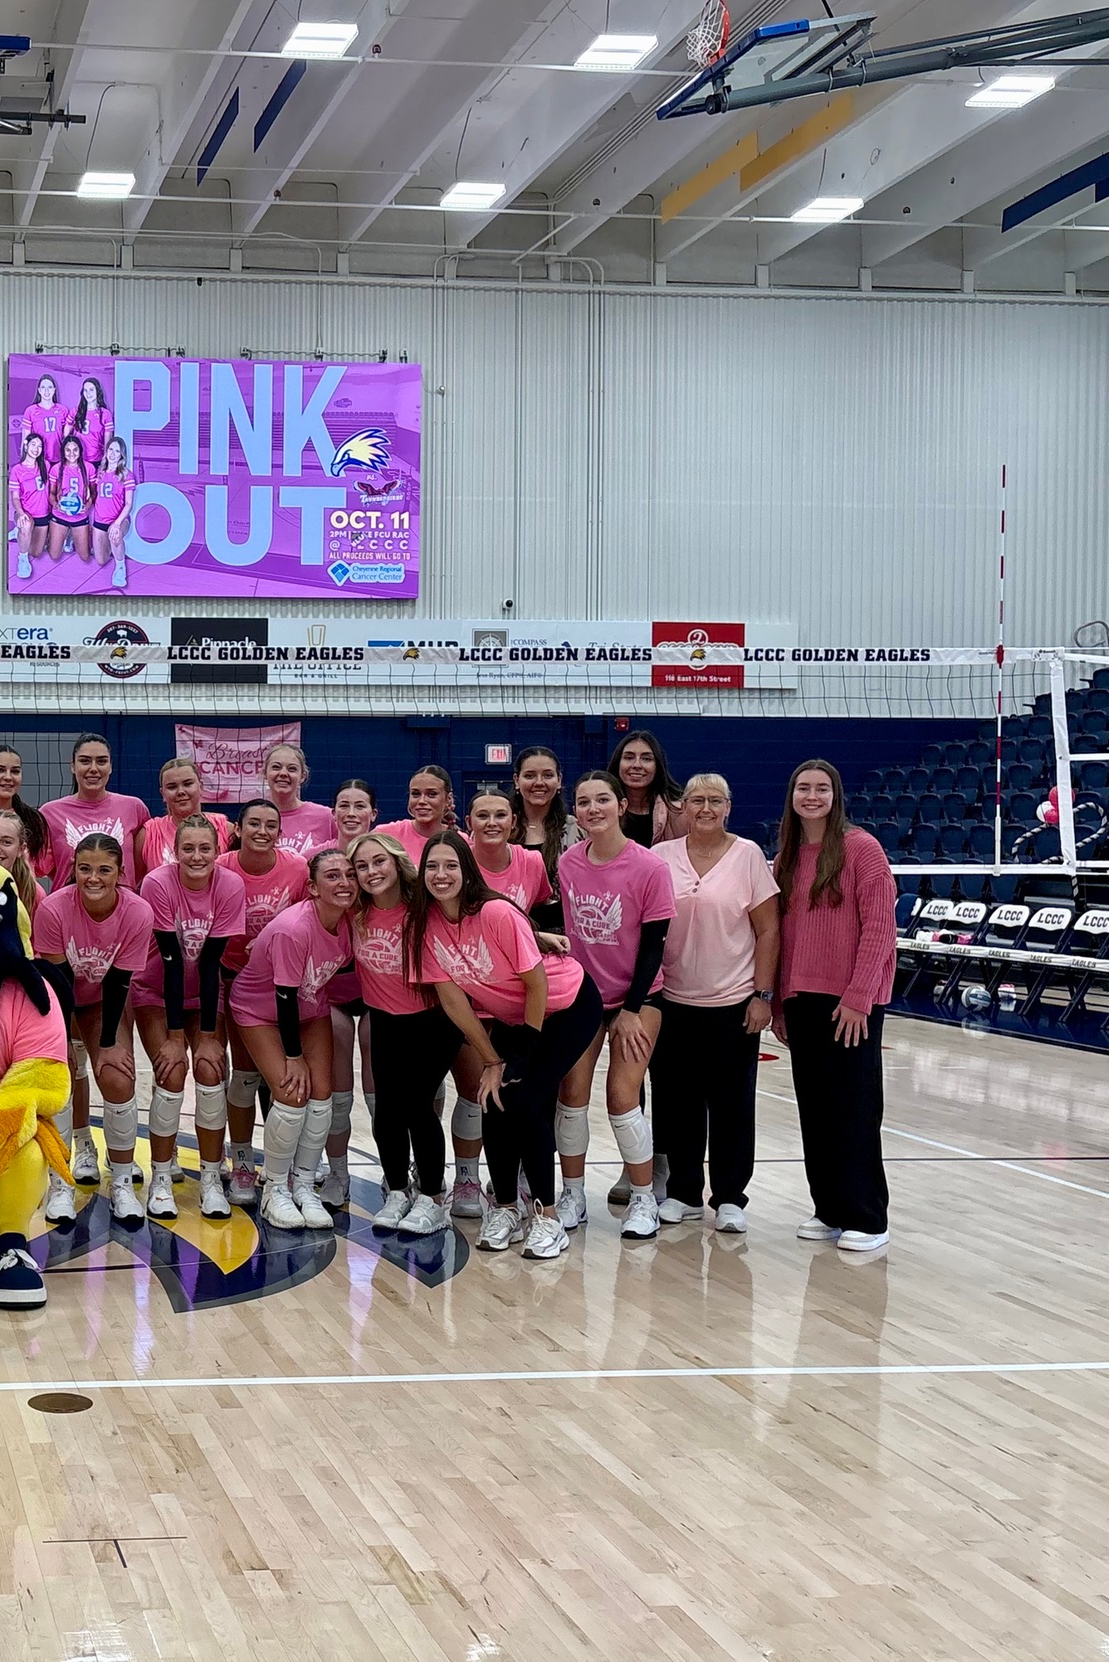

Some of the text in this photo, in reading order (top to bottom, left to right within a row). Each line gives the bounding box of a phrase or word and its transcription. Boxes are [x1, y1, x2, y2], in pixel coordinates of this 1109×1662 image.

[113, 360, 347, 477] PINK
[99, 482, 113, 498] 12
[125, 481, 346, 566] OUT
[330, 510, 410, 529] OCT. 11
[329, 530, 347, 538] 2PM
[374, 531, 391, 539] FCU
[392, 531, 410, 539] RAC
[342, 552, 374, 560] PROCEEDS
[375, 552, 391, 560] WILL
[352, 565, 402, 573] Cheyenne Regional
[378, 573, 402, 581] Center
[1, 644, 71, 660] EAGLES
[167, 646, 364, 661] LCCC GOLDEN EAGLES
[458, 648, 652, 662] LCCC GOLDEN EAGLES
[744, 648, 931, 662] LCCC GOLDEN EAGLES
[709, 675, 731, 683] Street
[77, 823, 112, 833] FLIGHT
[575, 893, 609, 911] FLIGHT
[927, 905, 948, 916] LCCC
[956, 907, 980, 919] LCCC
[997, 910, 1023, 921] LCCC
[1037, 913, 1065, 924] LCCC
[1083, 915, 1109, 928] LCCC
[592, 920, 611, 930] CURE
[366, 928, 398, 942] LIGHT
[78, 947, 111, 959] FLIGHT
[379, 953, 399, 961] CURE
